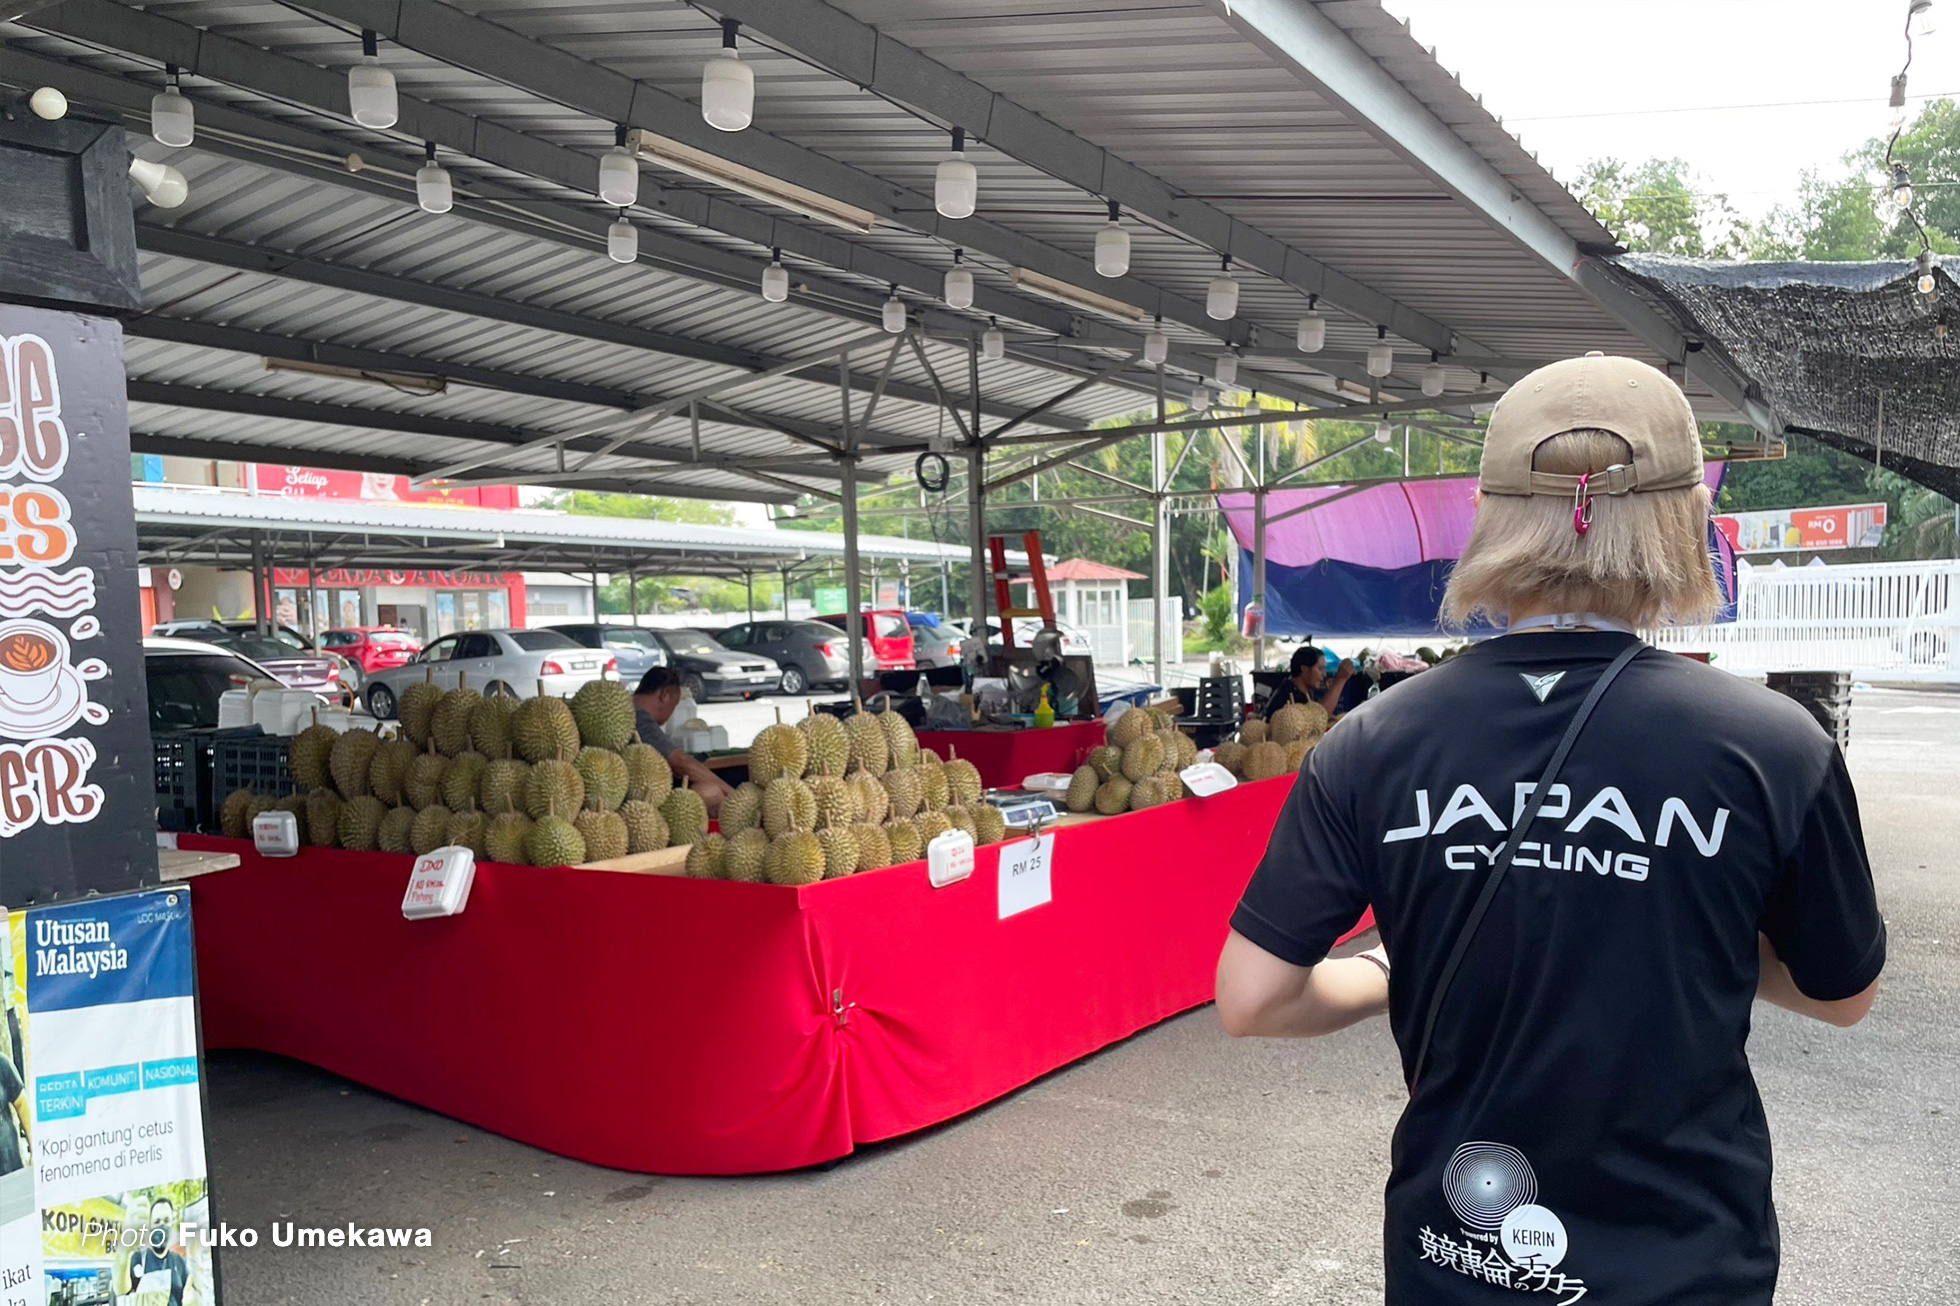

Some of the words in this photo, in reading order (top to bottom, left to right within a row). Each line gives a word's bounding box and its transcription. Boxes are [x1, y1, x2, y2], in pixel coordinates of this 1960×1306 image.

[1382, 781, 1731, 858] JAPAN
[1012, 860, 1028, 877] RM
[1030, 856, 1042, 871] 25
[1444, 841, 1651, 882] CYCLING
[35, 919, 110, 947] Utusan
[35, 942, 128, 979] Malaysia
[87, 1070, 137, 1090] KOMUNITI
[145, 1064, 198, 1081] NASIONAL
[39, 1095, 84, 1113] TERKINI
[138, 1120, 174, 1139] cetus
[40, 1156, 111, 1183] fenomena
[114, 1151, 127, 1169] di
[129, 1145, 163, 1166] Perlis
[41, 1208, 84, 1233] KOPI
[1489, 1232, 1499, 1246] by
[1511, 1228, 1556, 1247] KEIRIN
